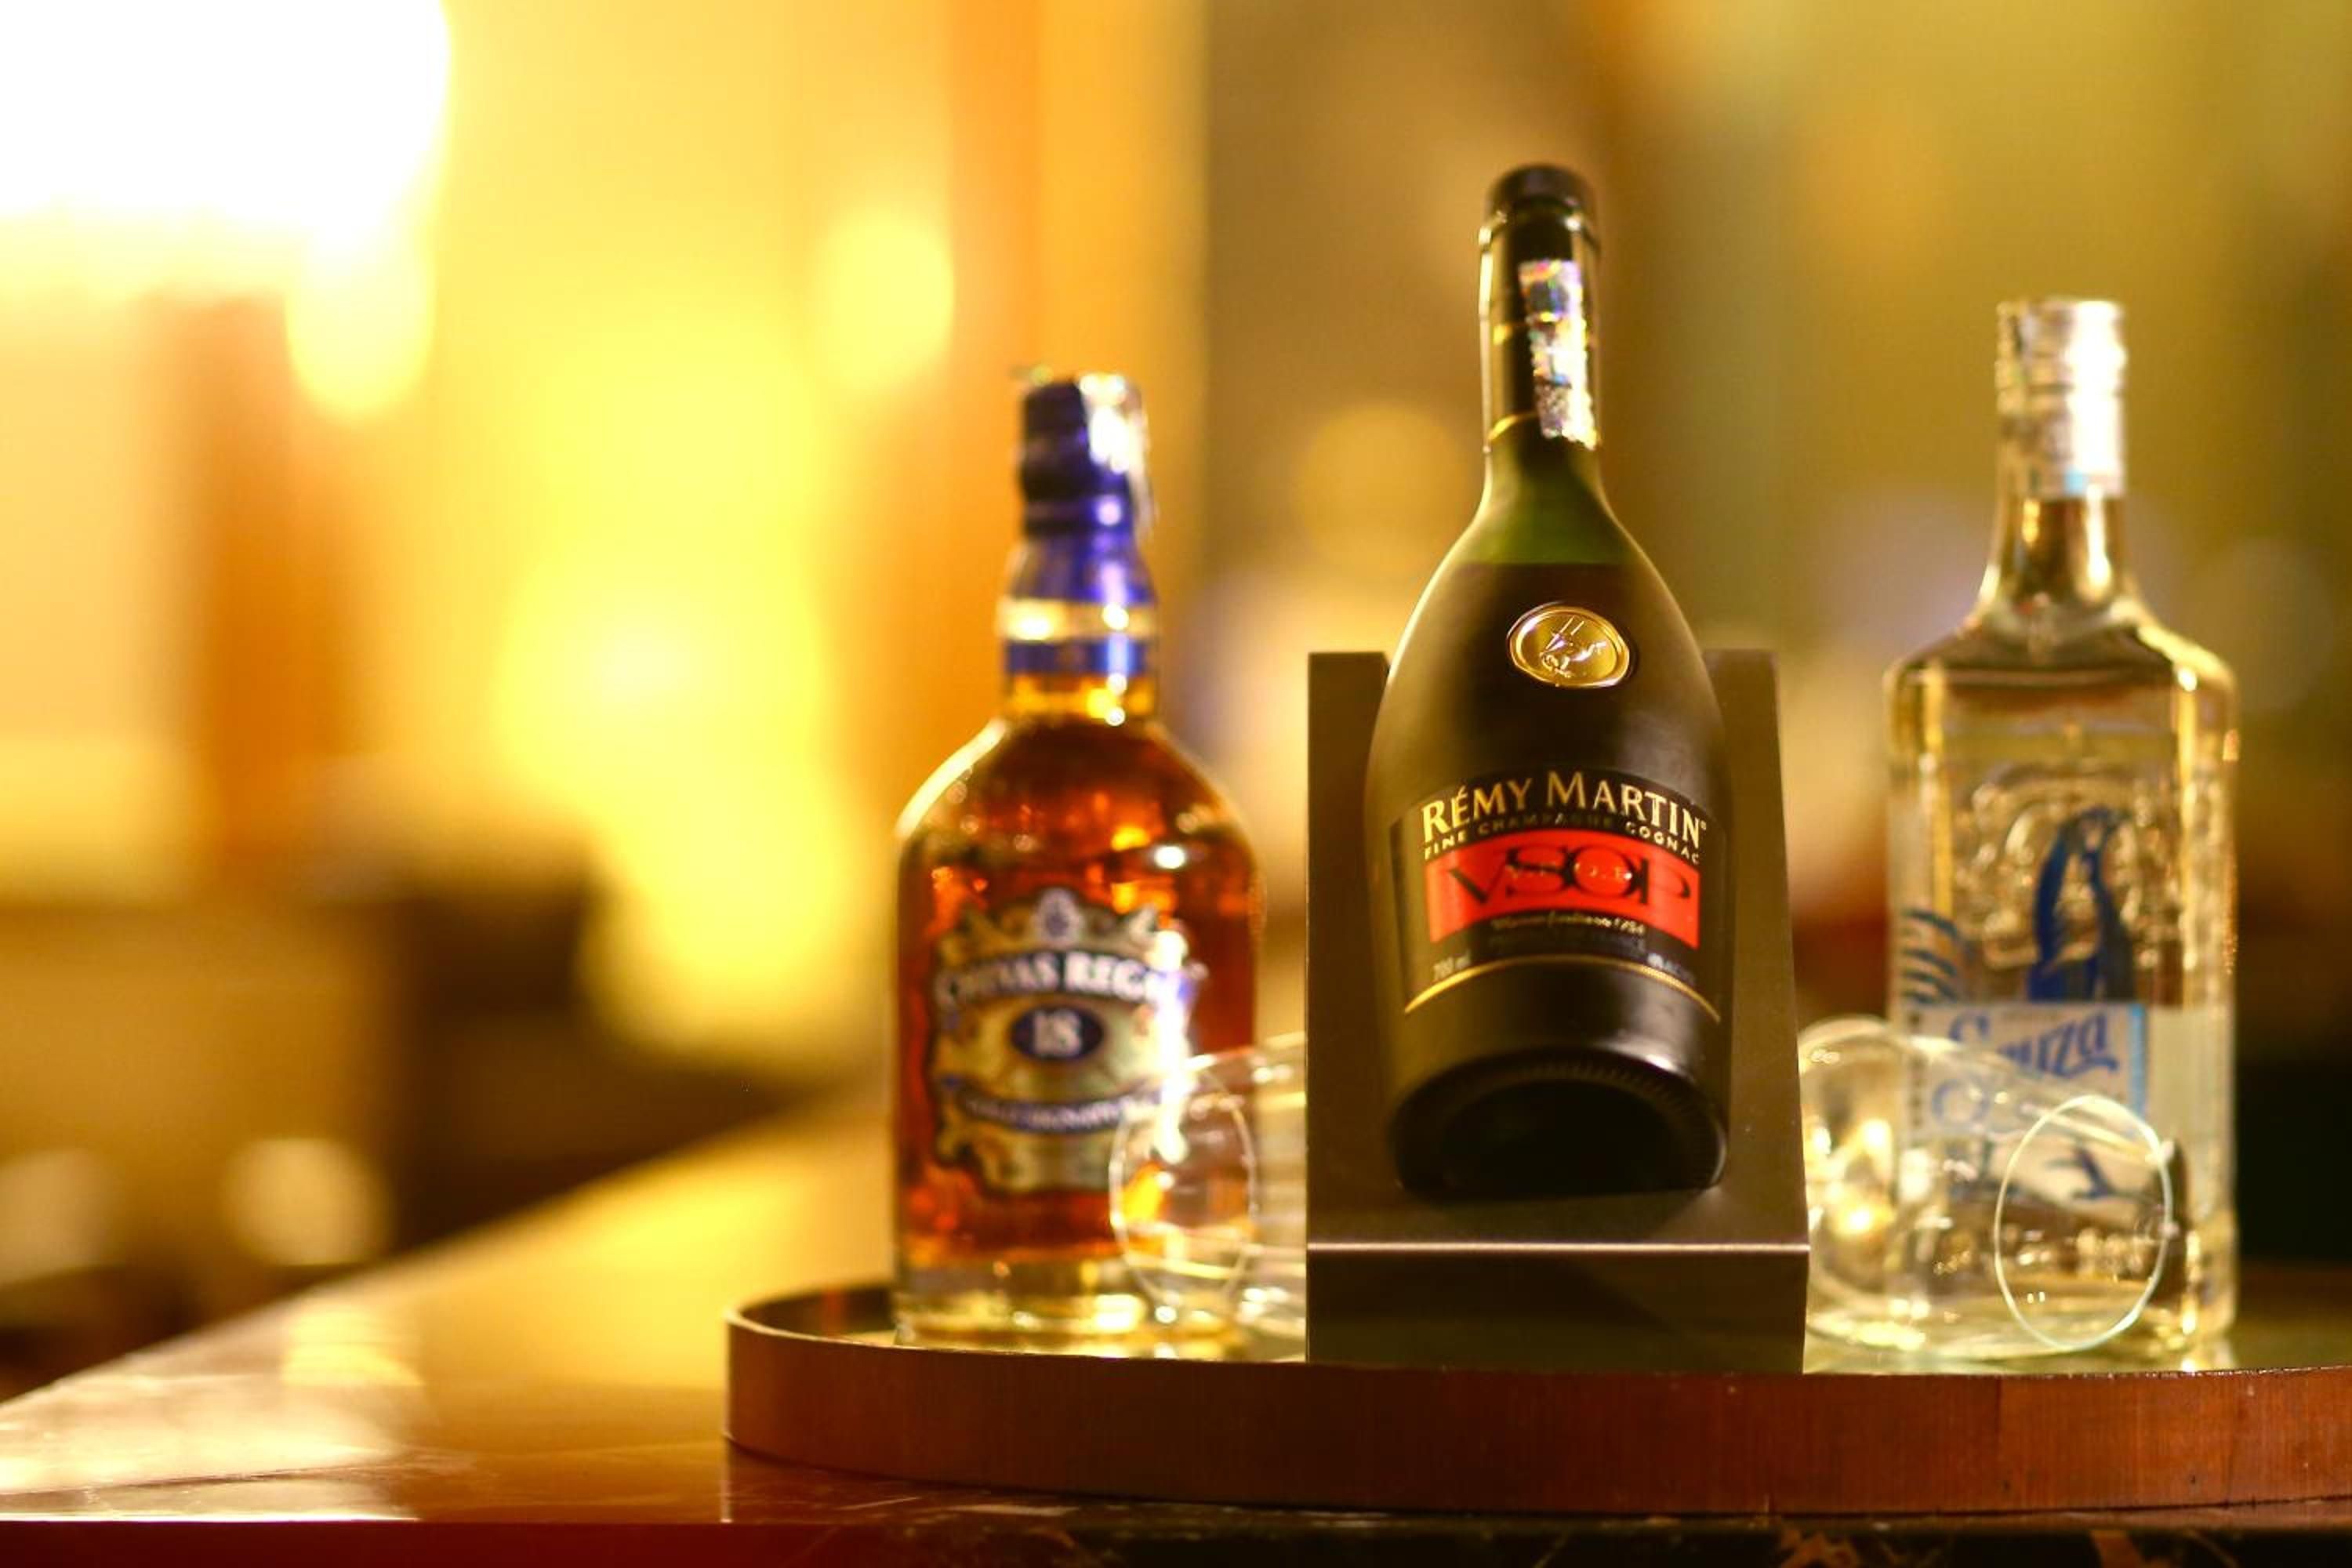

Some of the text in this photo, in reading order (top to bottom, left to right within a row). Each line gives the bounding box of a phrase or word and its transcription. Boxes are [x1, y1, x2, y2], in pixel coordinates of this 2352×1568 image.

[1421, 771, 1700, 849] RÉMY MARTIN
[1425, 829, 1467, 861] FINE
[1625, 821, 1700, 865] COGNAC
